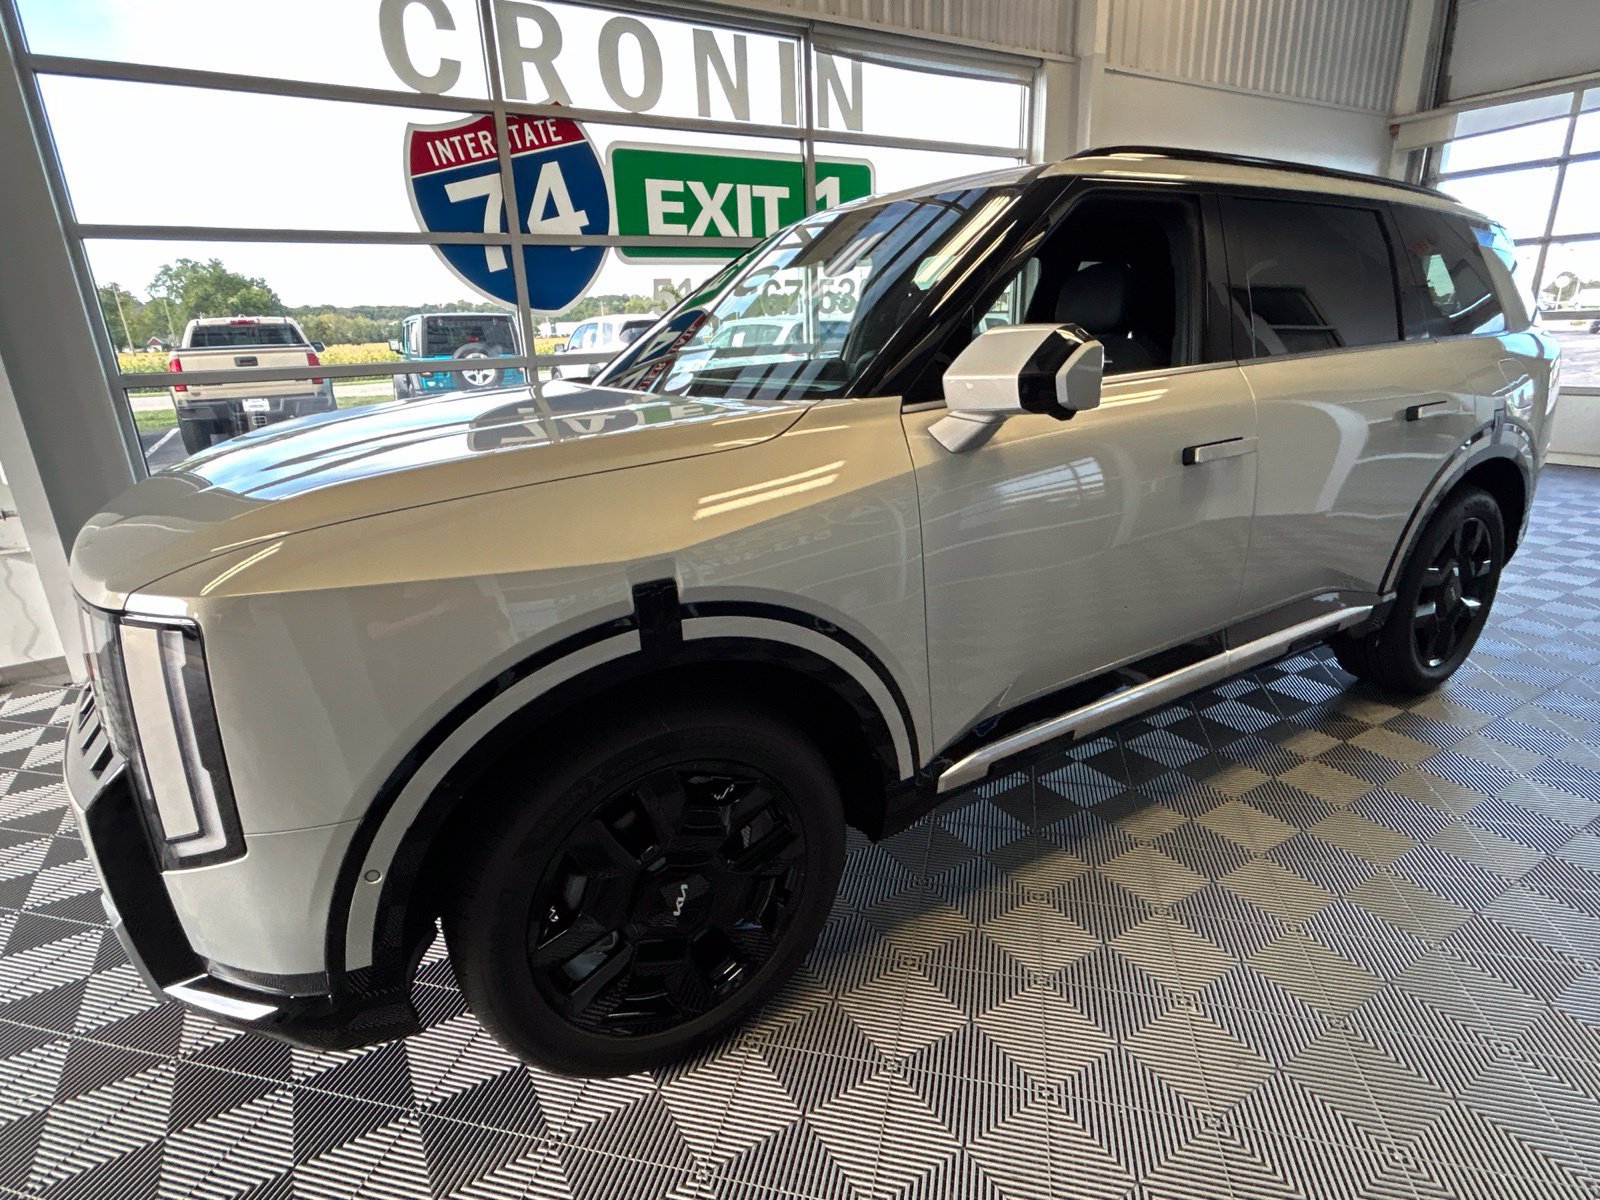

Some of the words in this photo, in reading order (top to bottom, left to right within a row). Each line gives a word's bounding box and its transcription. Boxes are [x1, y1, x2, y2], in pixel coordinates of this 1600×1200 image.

[379, 0, 863, 131] CRONIN
[426, 118, 564, 167] INTERTATE
[443, 160, 590, 273] 74
[644, 178, 790, 238] EXIT
